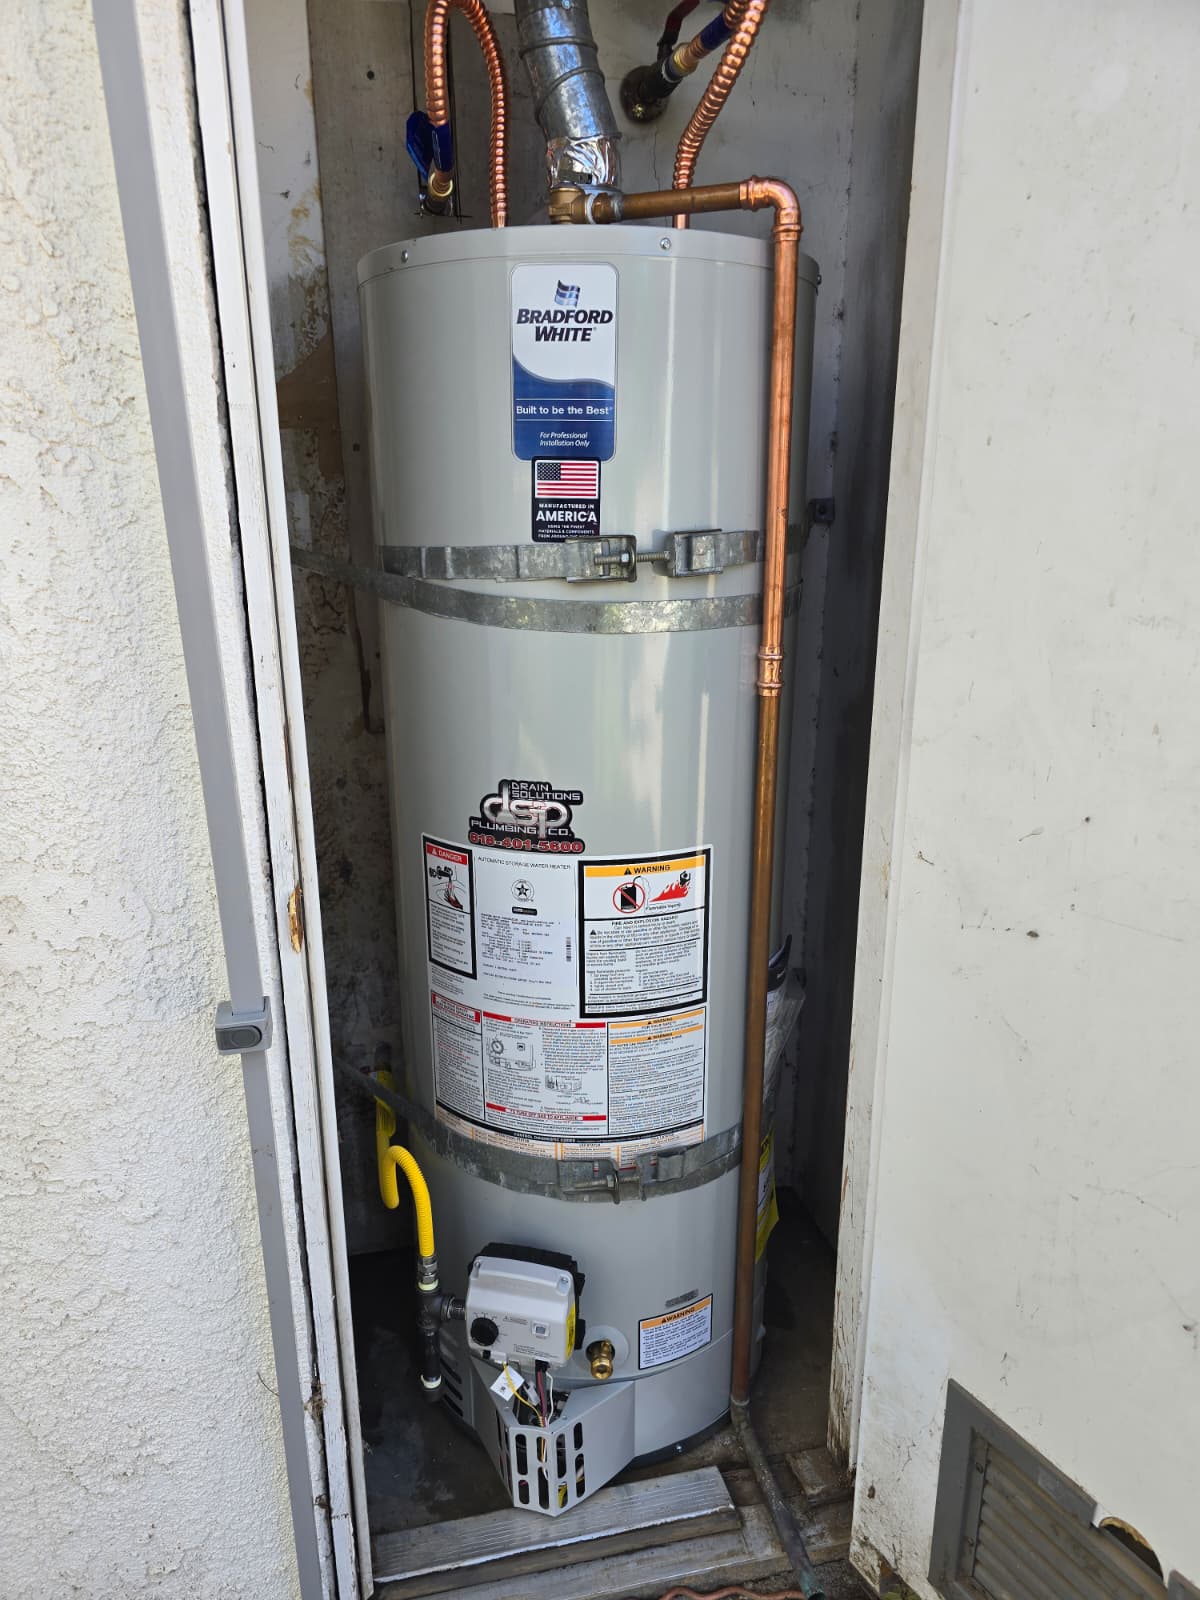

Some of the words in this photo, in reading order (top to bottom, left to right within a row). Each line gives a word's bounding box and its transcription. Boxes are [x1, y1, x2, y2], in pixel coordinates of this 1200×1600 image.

[516, 308, 614, 324] BRADFORD
[516, 405, 537, 415] Built
[539, 405, 549, 415] to
[552, 405, 565, 415] be
[567, 405, 584, 415] the
[550, 431, 588, 439] Professional
[575, 440, 590, 448] Only
[536, 510, 598, 522] AMERICA
[511, 782, 549, 792] DRAIN
[511, 791, 581, 801] SOLUTIONS
[471, 819, 537, 834] PLUMBING
[633, 864, 671, 874] WARNING
[666, 1307, 695, 1322] WARNING
